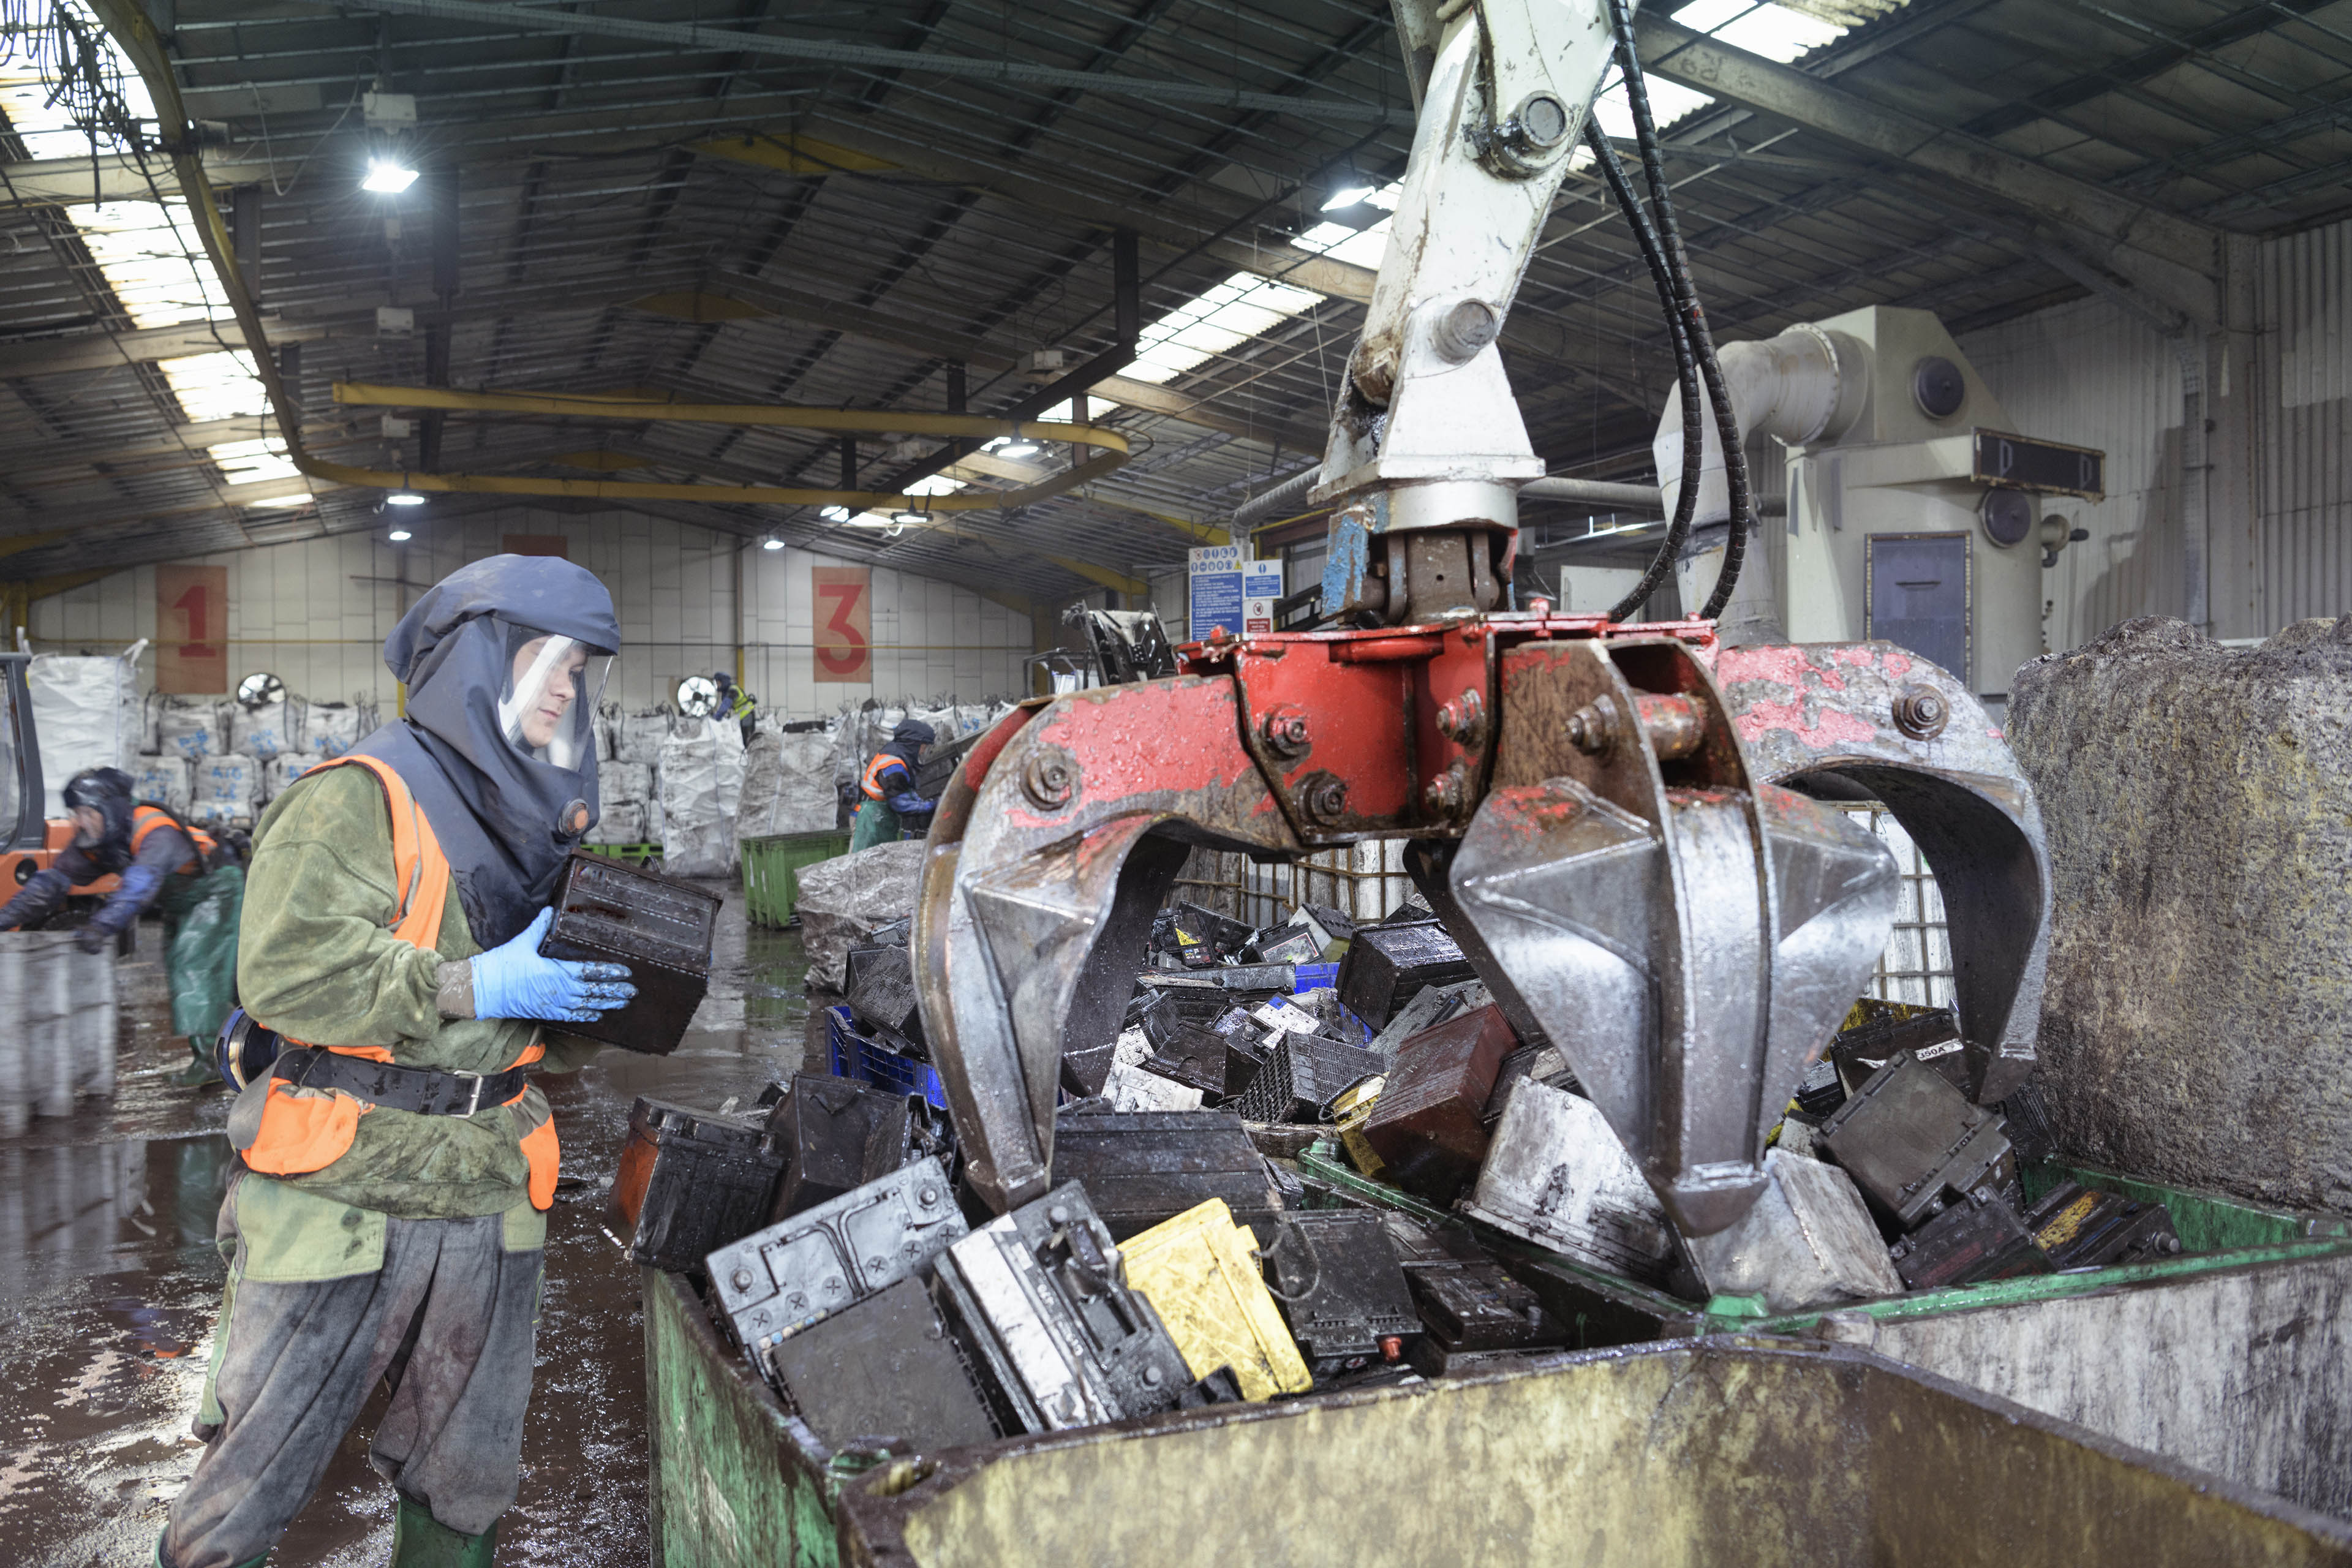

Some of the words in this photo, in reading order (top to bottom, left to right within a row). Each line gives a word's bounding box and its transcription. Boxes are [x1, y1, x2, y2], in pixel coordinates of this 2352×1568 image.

[174, 585, 217, 658] 1
[816, 584, 867, 674] 3
[1919, 1046, 1946, 1059] 350A
